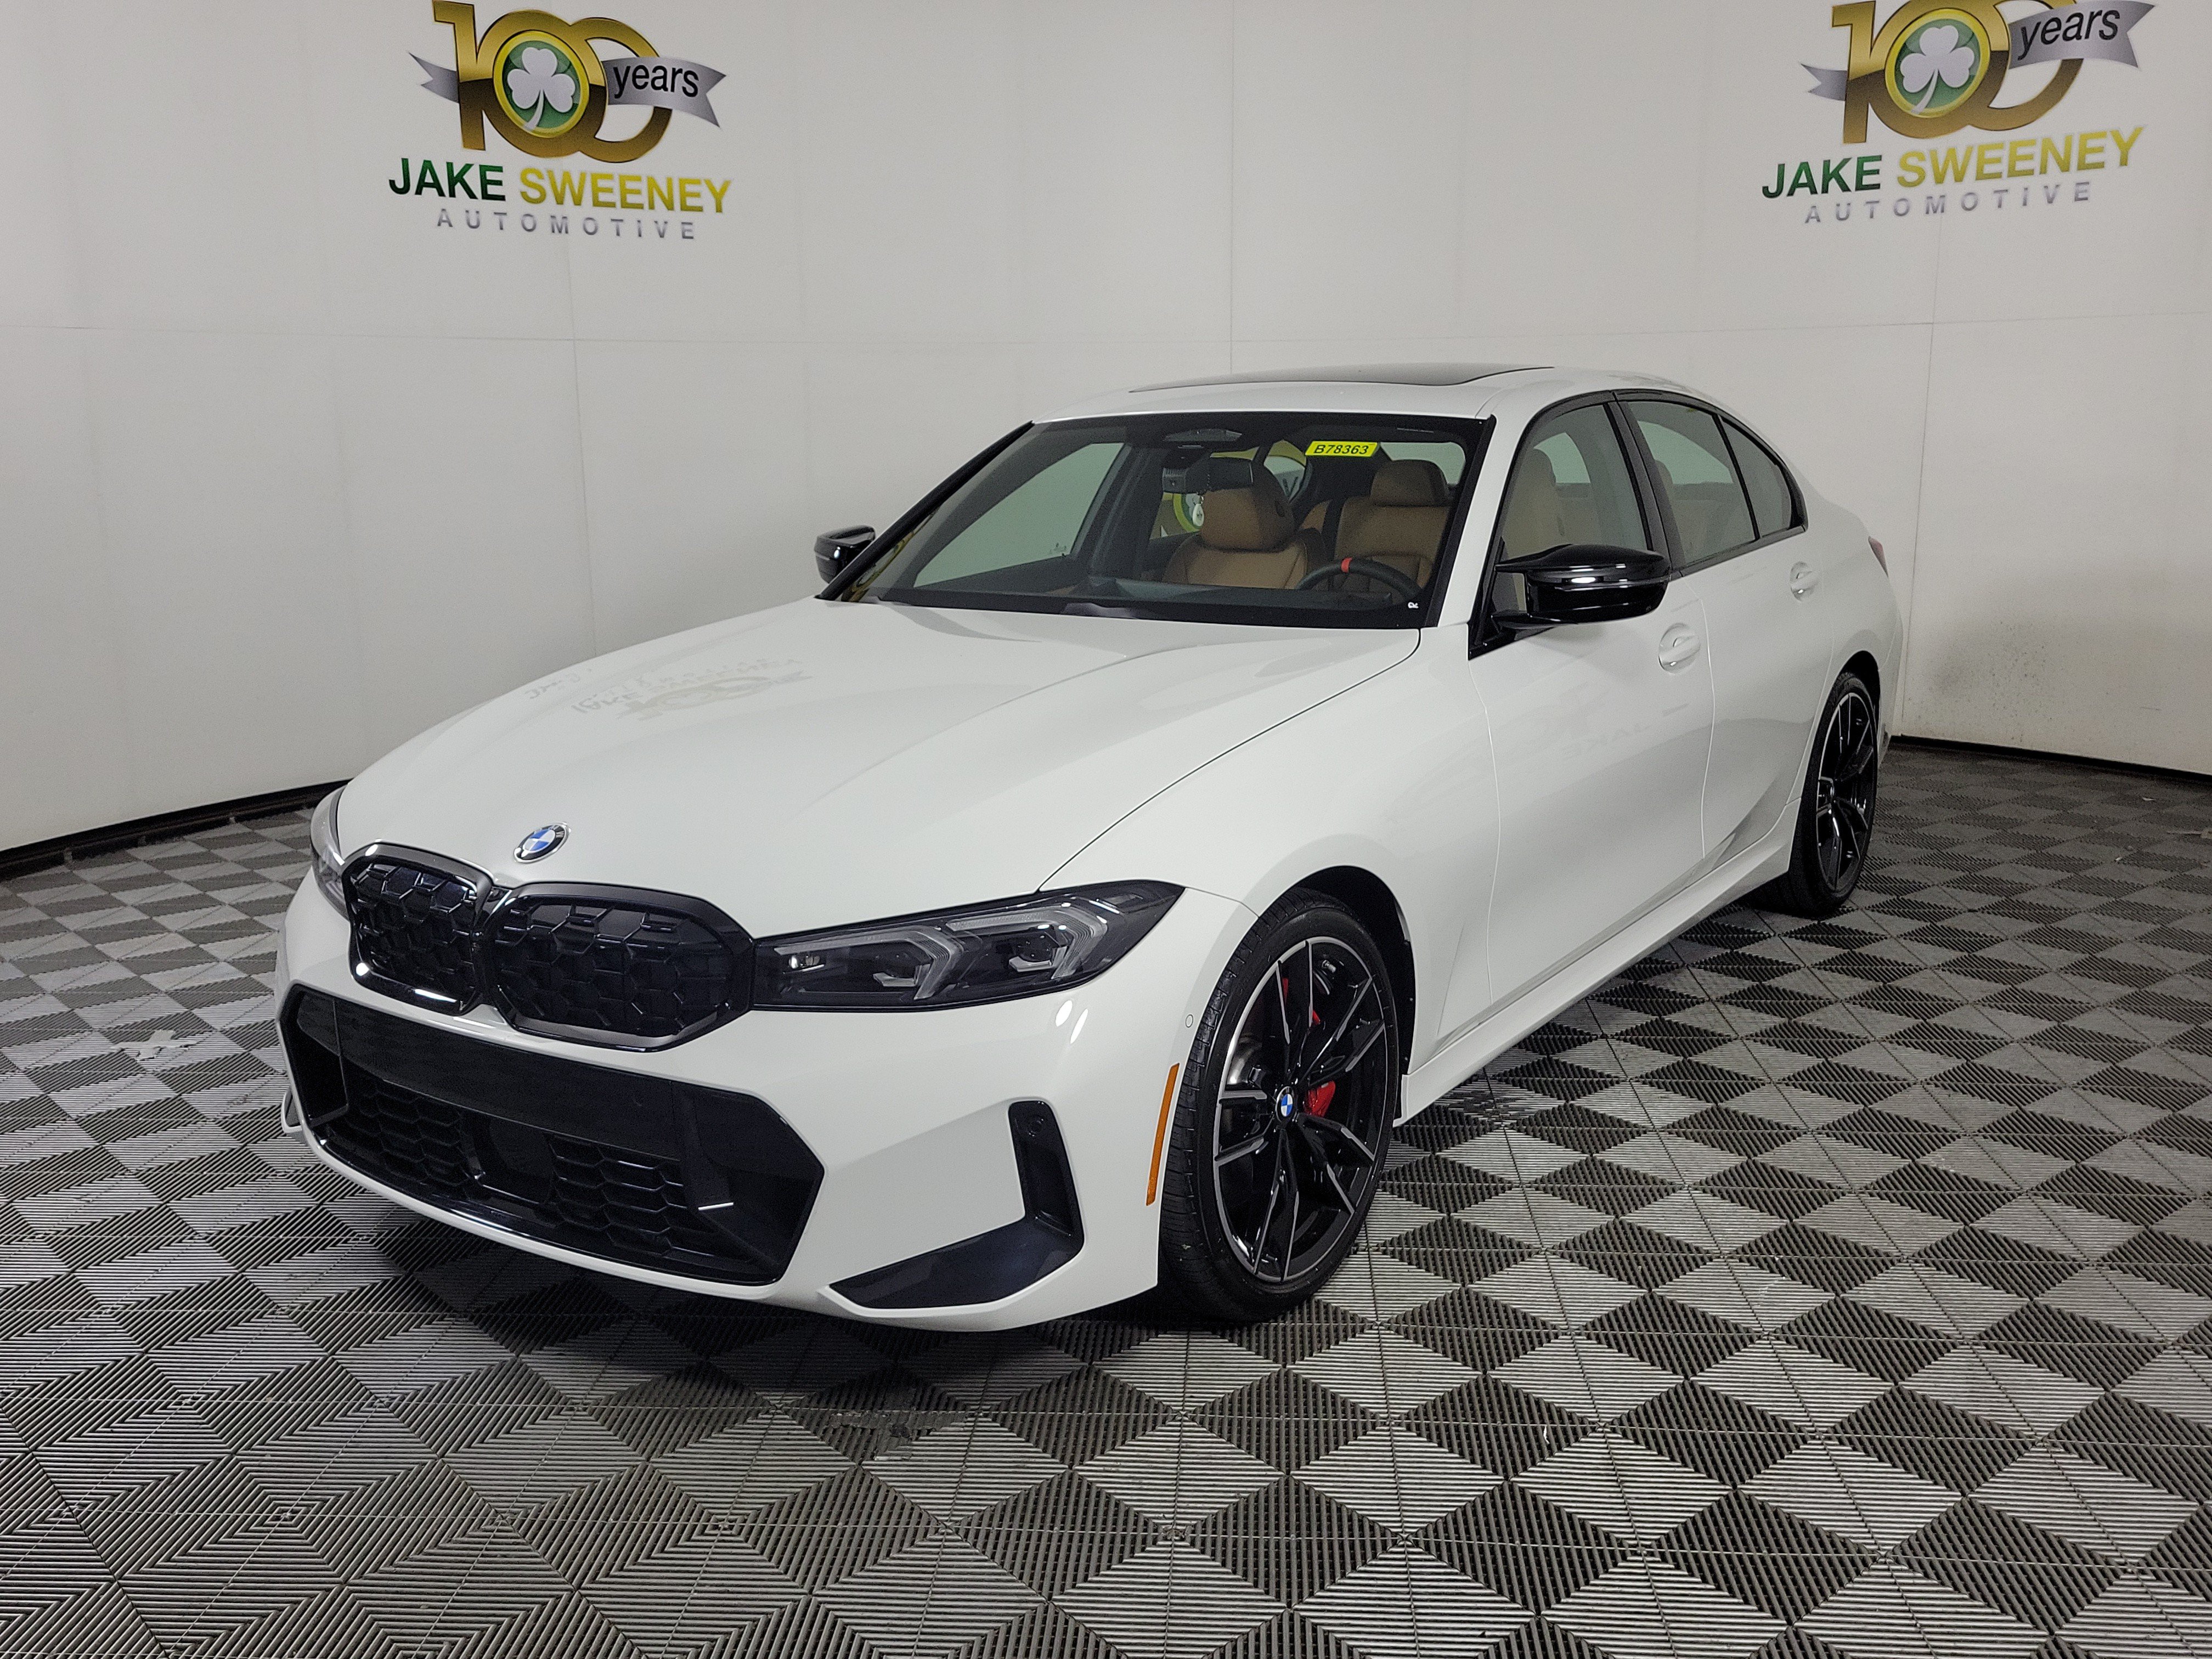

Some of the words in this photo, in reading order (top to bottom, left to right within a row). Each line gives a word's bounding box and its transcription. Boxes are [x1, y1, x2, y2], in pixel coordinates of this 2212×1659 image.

[2017, 9, 2121, 61] years
[613, 63, 699, 98] years
[1762, 155, 1883, 199] JAKE
[1897, 126, 2145, 188] SWEENEY
[388, 157, 506, 201] JAKE
[520, 167, 732, 213] SWEENEY
[1805, 182, 2091, 224] AUTOMOTIVE
[437, 208, 695, 239] AUTOMOTIVE
[1313, 444, 1369, 454] B78363
